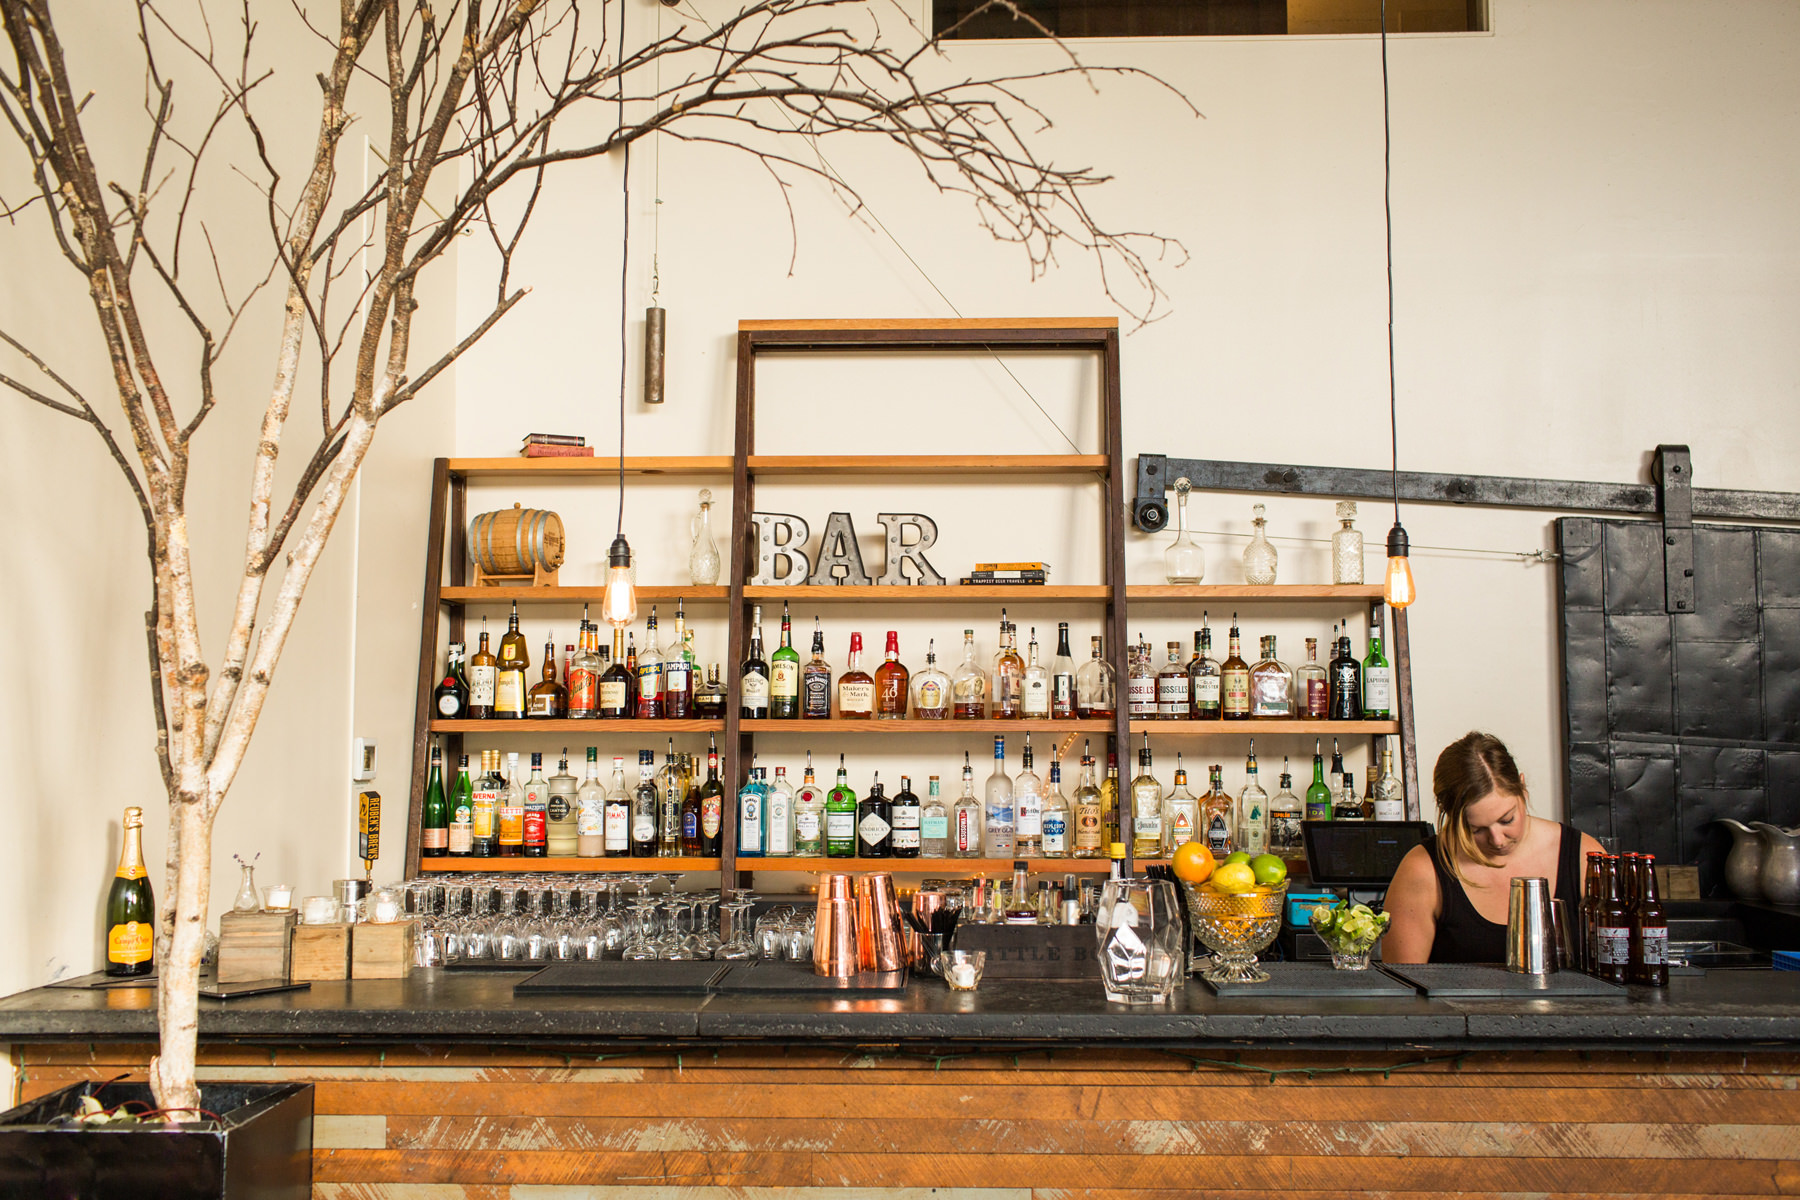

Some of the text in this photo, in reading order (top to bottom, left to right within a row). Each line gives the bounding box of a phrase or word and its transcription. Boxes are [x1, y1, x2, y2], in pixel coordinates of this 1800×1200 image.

[751, 511, 946, 586] BAR
[638, 665, 661, 675] APEROL
[881, 686, 898, 702] 46
[1129, 686, 1154, 695] USSELL'S
[472, 792, 496, 800] AVERNA
[500, 807, 522, 815] ELETTI
[606, 809, 626, 820] PIMM'S
[1079, 806, 1099, 815] Tito's
[367, 797, 380, 860] REUBEN'S BREWS
